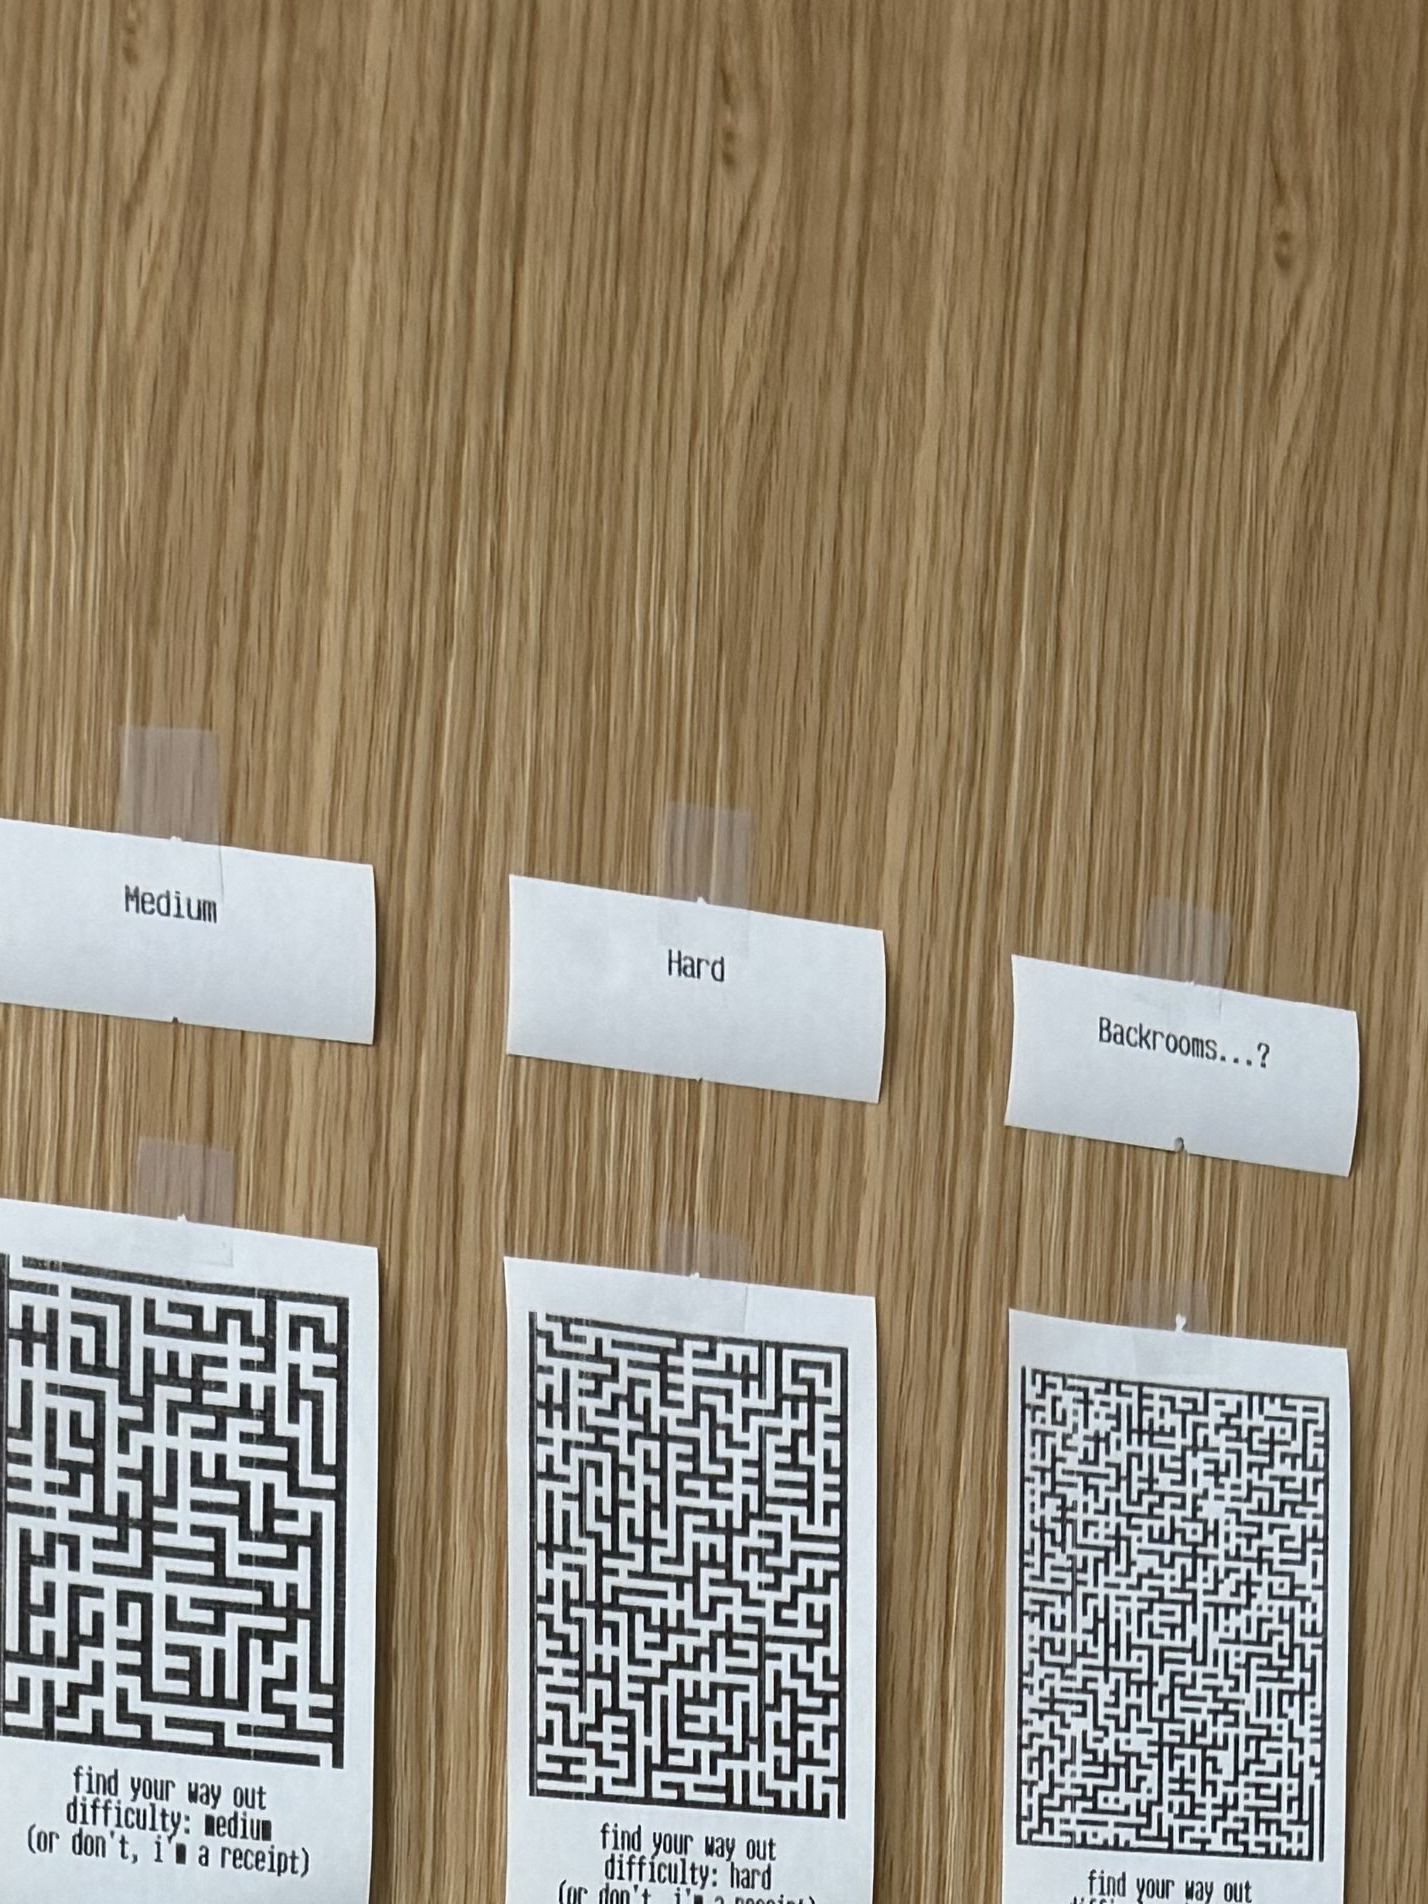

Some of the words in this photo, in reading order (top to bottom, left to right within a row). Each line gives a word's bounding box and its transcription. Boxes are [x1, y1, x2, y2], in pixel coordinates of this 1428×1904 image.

[124, 884, 218, 924] Medium
[667, 948, 725, 983] Hard
[1098, 1016, 1270, 1069] Backrooms...?
[73, 1765, 118, 1797] find
[131, 1776, 175, 1802] your
[188, 1782, 221, 1810] way
[233, 1786, 266, 1810] out
[600, 1822, 641, 1852] find
[653, 1832, 693, 1858] your
[705, 1836, 735, 1863] way
[746, 1838, 776, 1861] out
[605, 1853, 717, 1890] difficulty:
[731, 1861, 771, 1890] hard
[1088, 1869, 1126, 1897] find
[1137, 1878, 1175, 1902] your
[1185, 1880, 1213, 1904] way
[1224, 1880, 1252, 1903] out
